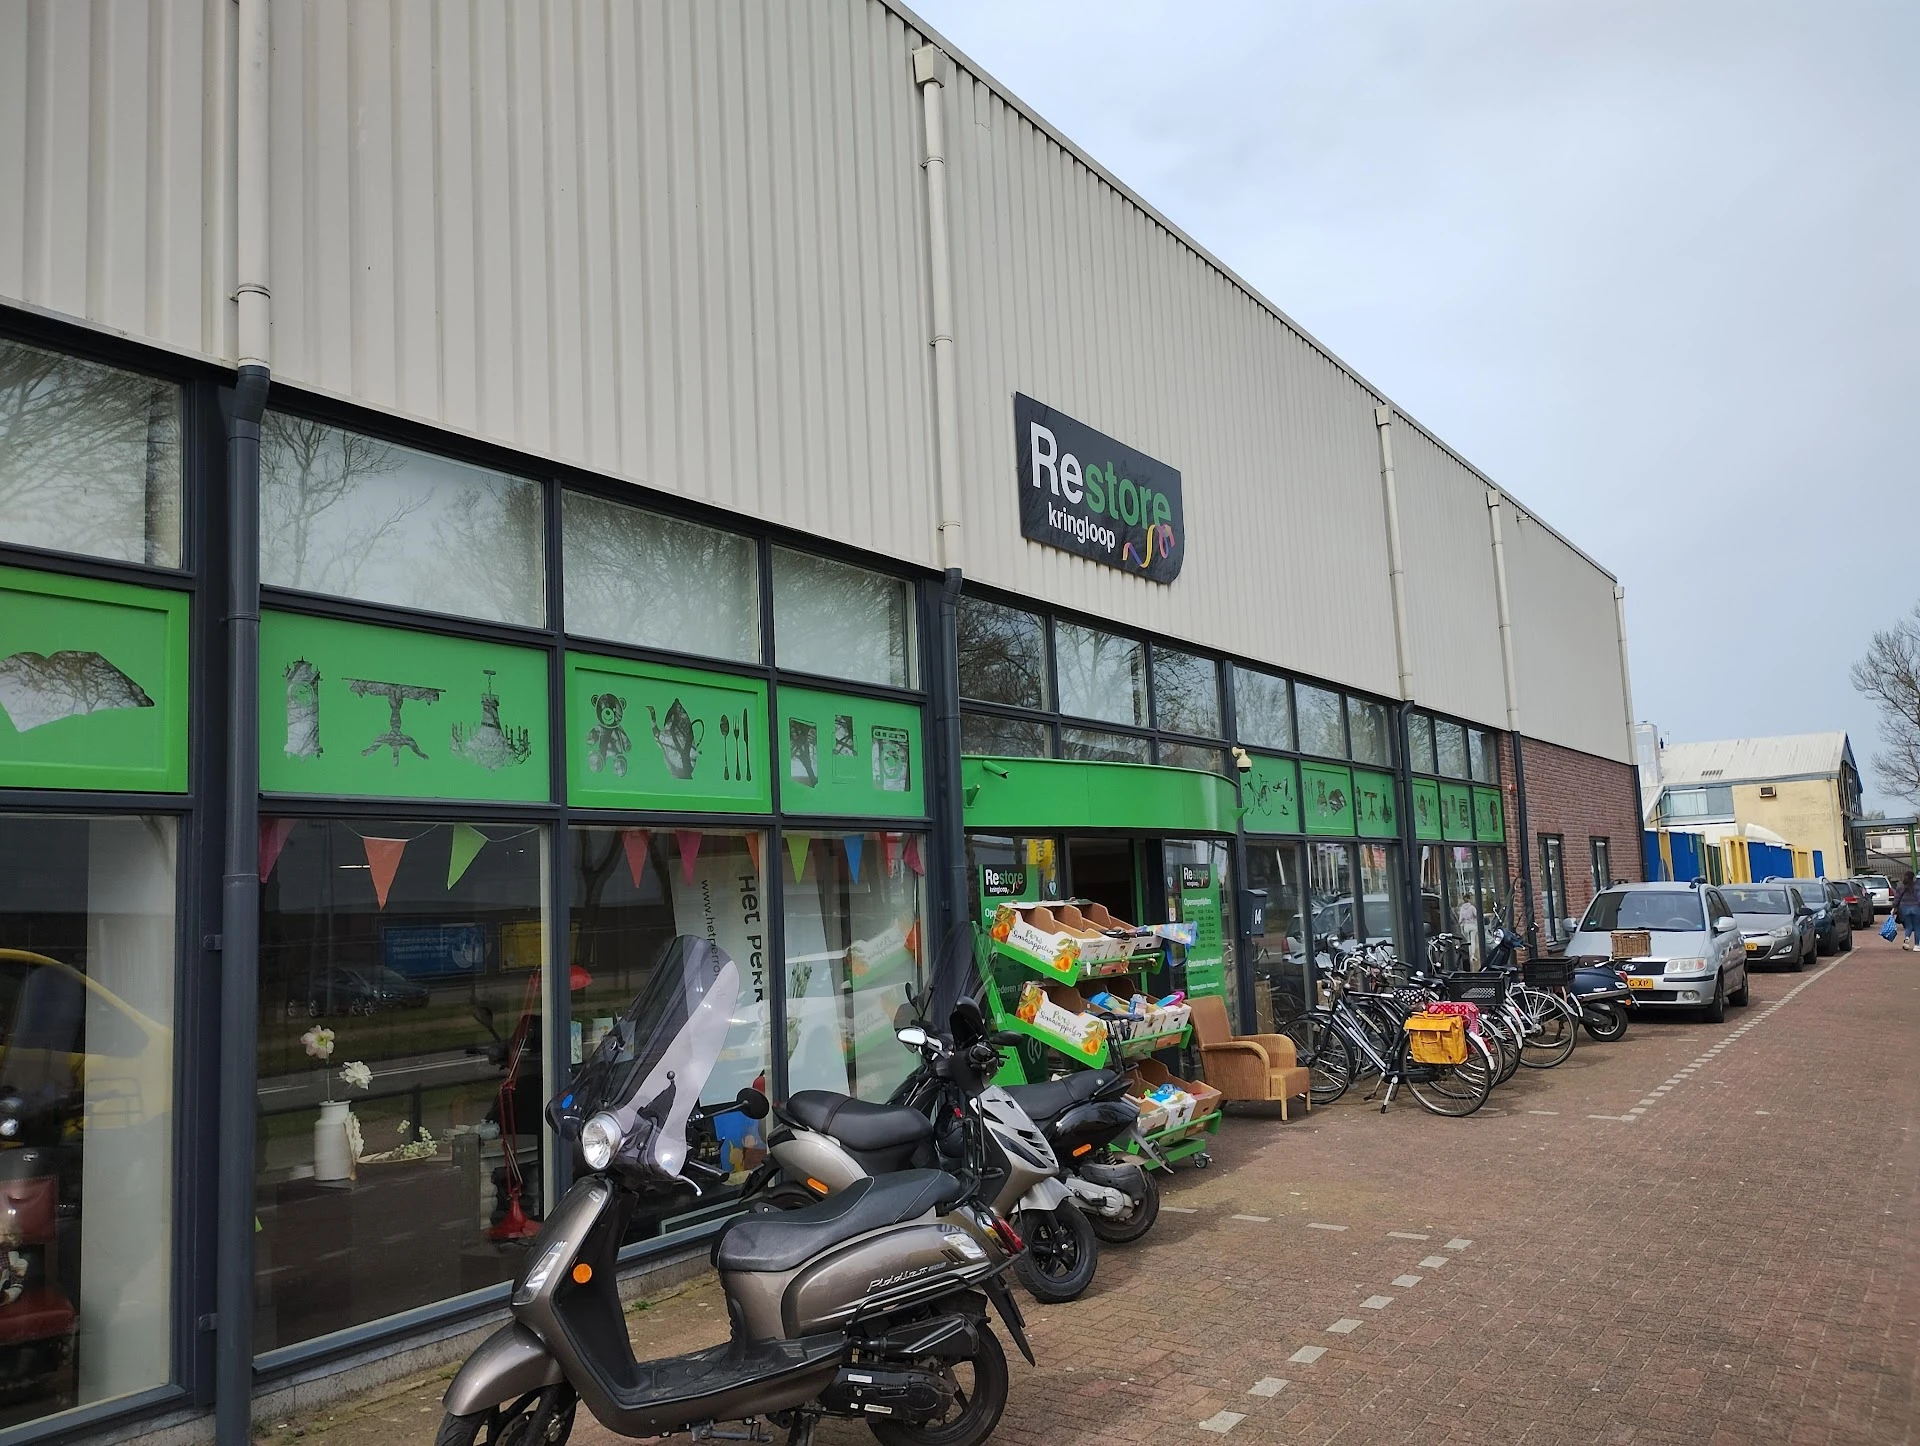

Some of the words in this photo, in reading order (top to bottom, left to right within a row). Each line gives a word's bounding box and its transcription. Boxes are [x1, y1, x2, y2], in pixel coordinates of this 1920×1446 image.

[1030, 421, 1172, 530] Restore
[1048, 502, 1116, 553] kringloop
[985, 868, 1024, 885] Restore
[1184, 867, 1209, 880] Restore
[738, 875, 761, 925] Het
[1025, 929, 1043, 944] Pers
